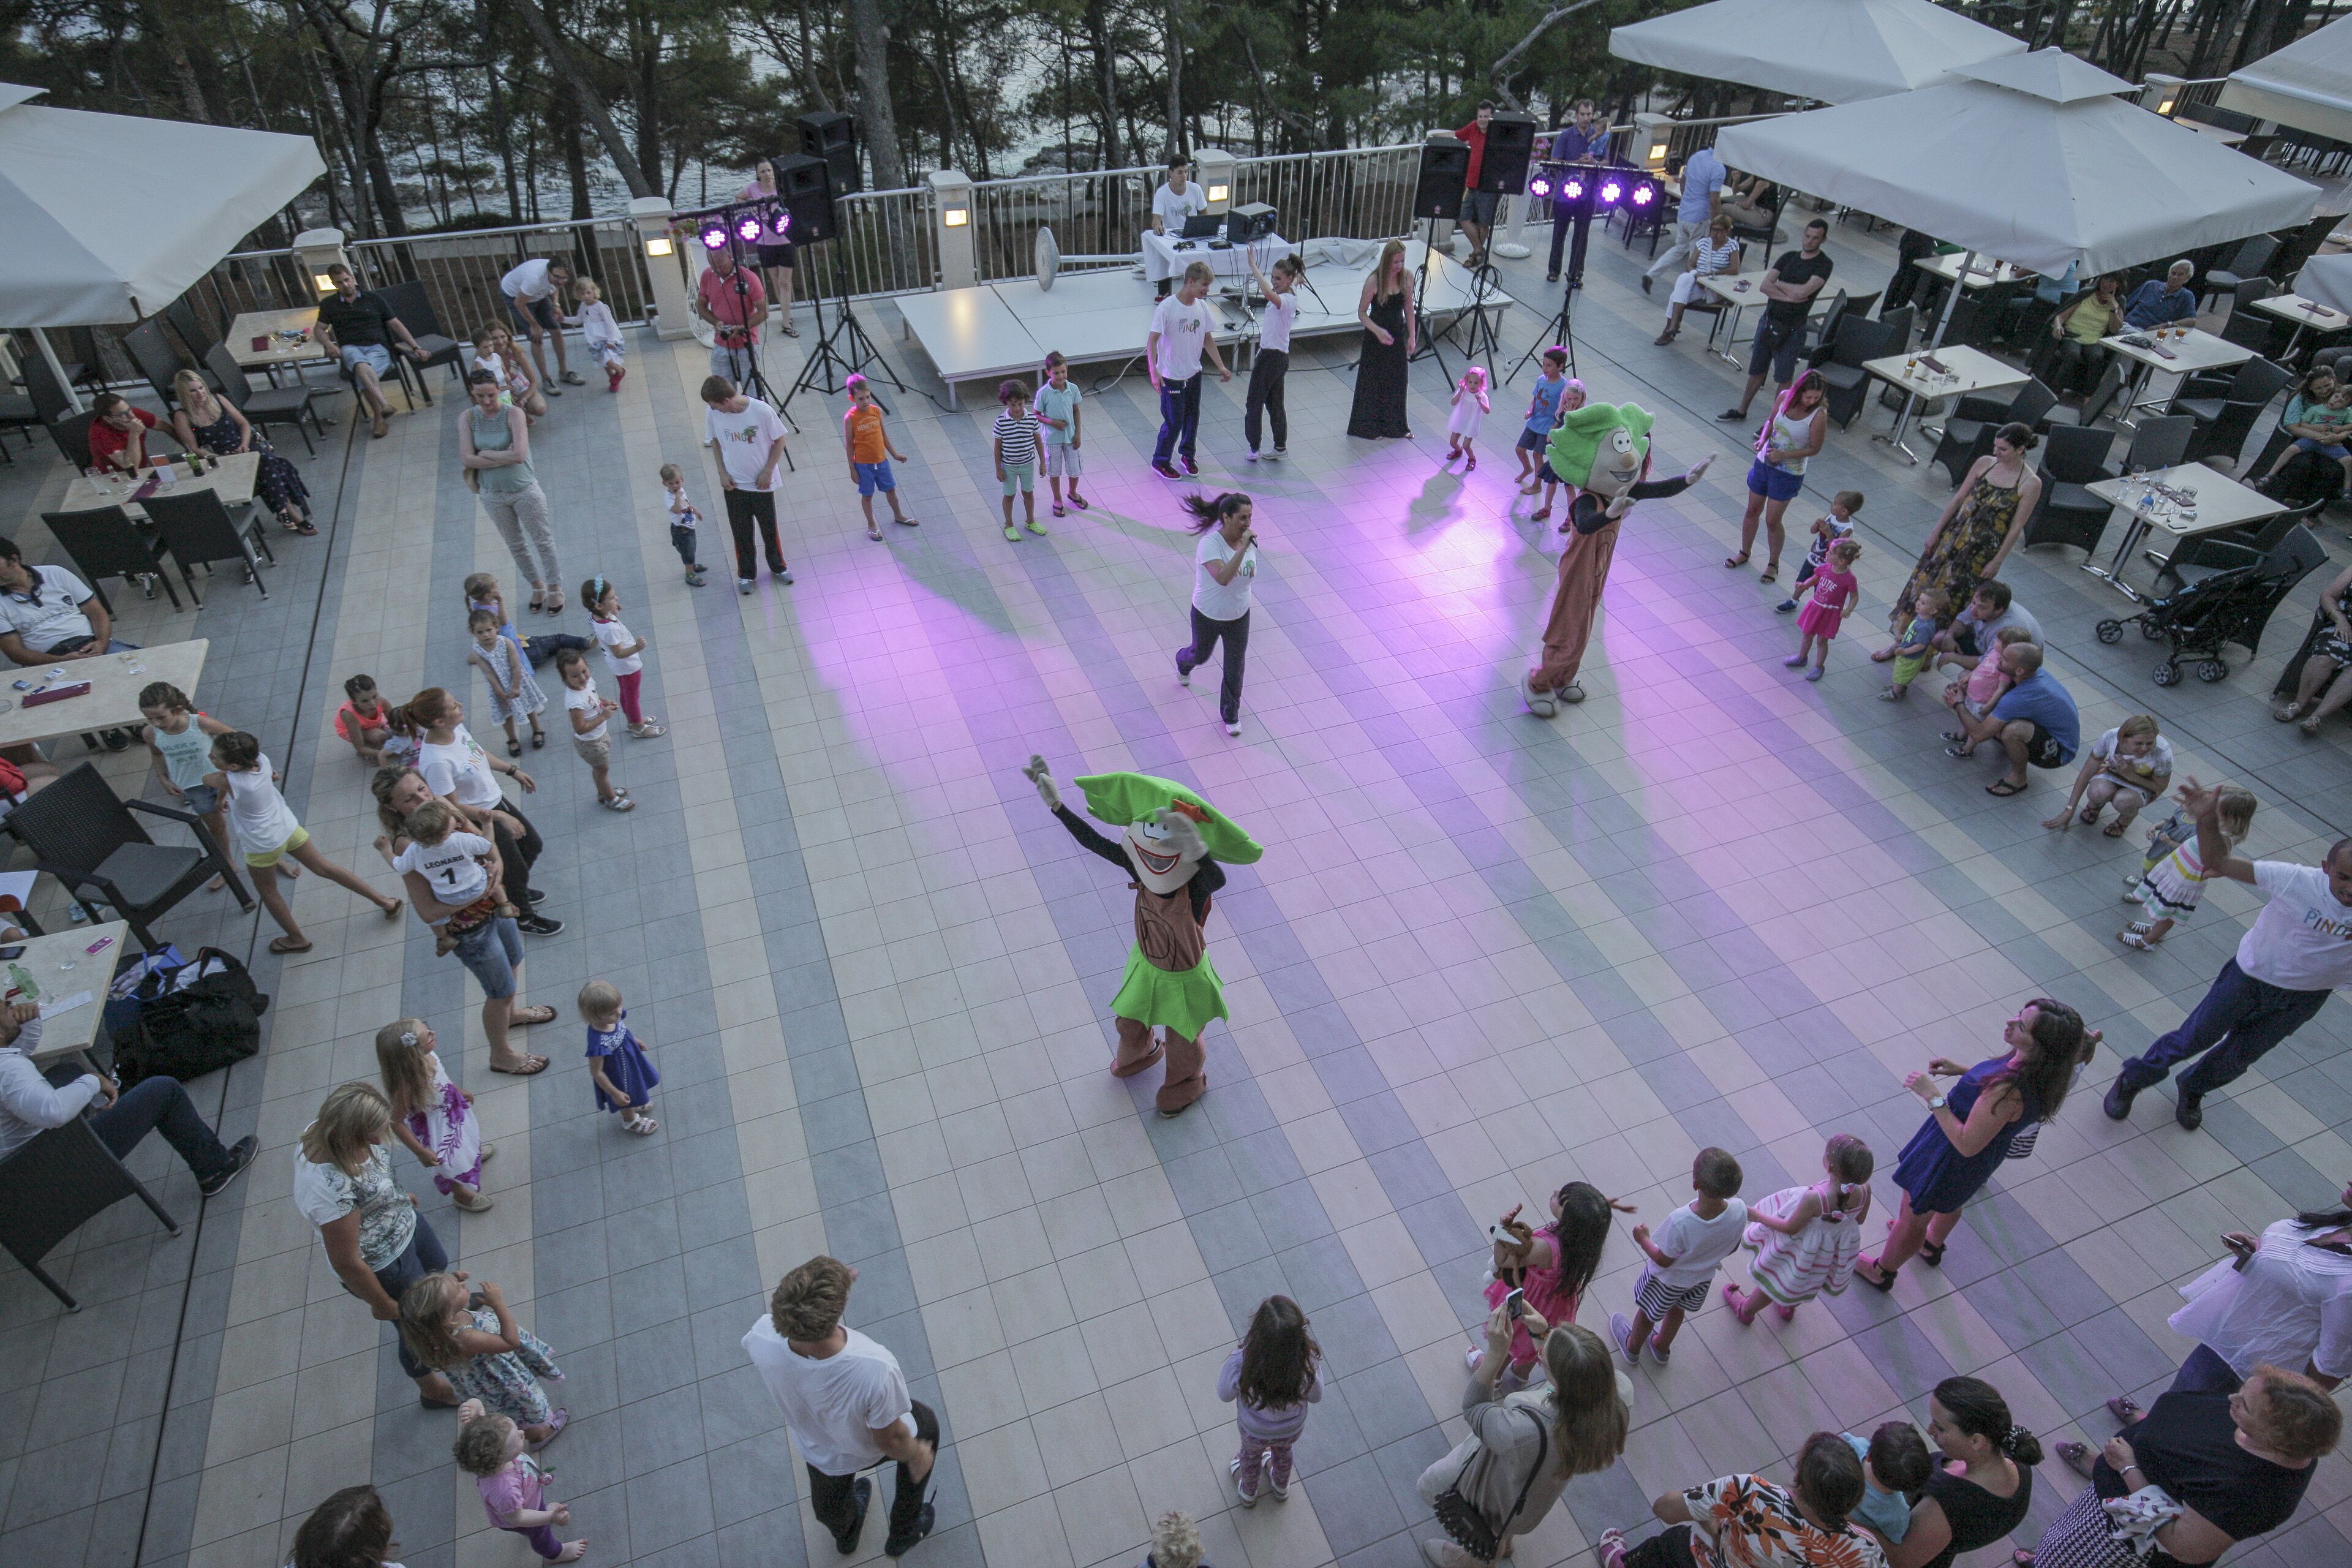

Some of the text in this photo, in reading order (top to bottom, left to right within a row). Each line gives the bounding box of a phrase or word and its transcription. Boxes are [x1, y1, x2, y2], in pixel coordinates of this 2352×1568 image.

[1178, 323, 1194, 333] PINO
[725, 431, 747, 442] PINO
[1819, 577, 1837, 592] CUTIE
[424, 855, 464, 869] LEONARD
[440, 867, 456, 884] 1
